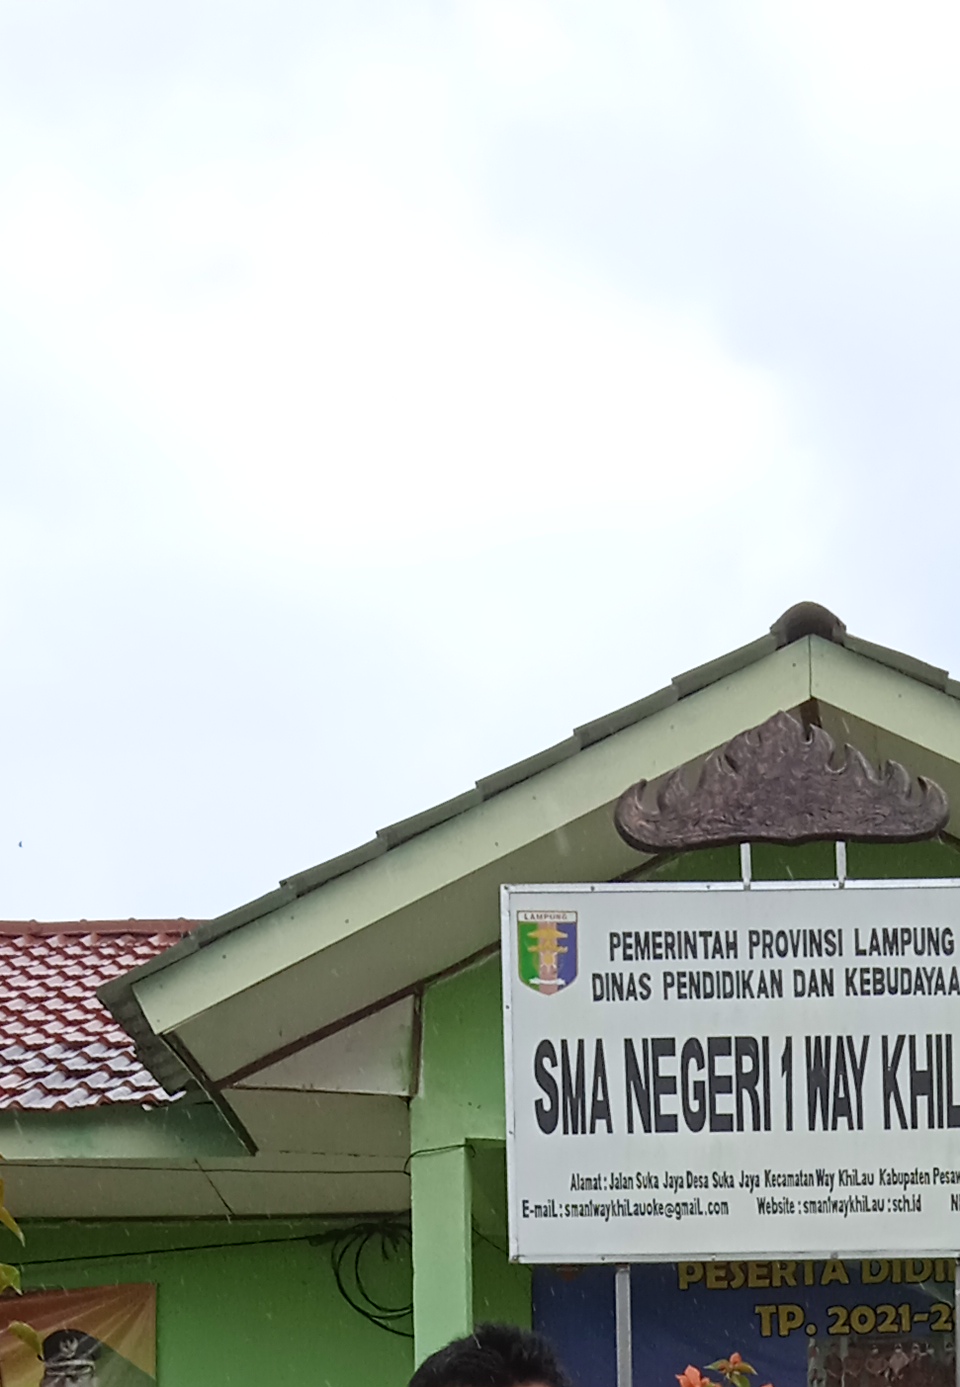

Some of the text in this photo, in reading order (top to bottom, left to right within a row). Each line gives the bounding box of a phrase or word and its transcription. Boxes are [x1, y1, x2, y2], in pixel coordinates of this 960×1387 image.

[609, 930, 738, 961] PEMERINTAH
[748, 928, 844, 959] PROVINSI
[854, 927, 955, 957] LAMPUNG
[592, 972, 652, 1002] DINAS
[662, 969, 783, 1000] PENDIDIKAN
[794, 968, 834, 998] DAN
[534, 1038, 613, 1135] SMA
[623, 1036, 772, 1134] NEGERI
[781, 1036, 793, 1132] 1
[805, 1035, 870, 1132] WAY
[636, 1171, 659, 1190] Suka
[663, 1171, 684, 1194] Jaya
[686, 1170, 709, 1189] Desa
[712, 1170, 735, 1189] Suka
[738, 1169, 760, 1194] Jaya
[764, 1169, 815, 1188] Kecamatan
[815, 1169, 835, 1193] Way
[879, 1167, 930, 1191] Kabupaten
[677, 1260, 850, 1290] PESERTA
[755, 1304, 817, 1337] TP.
